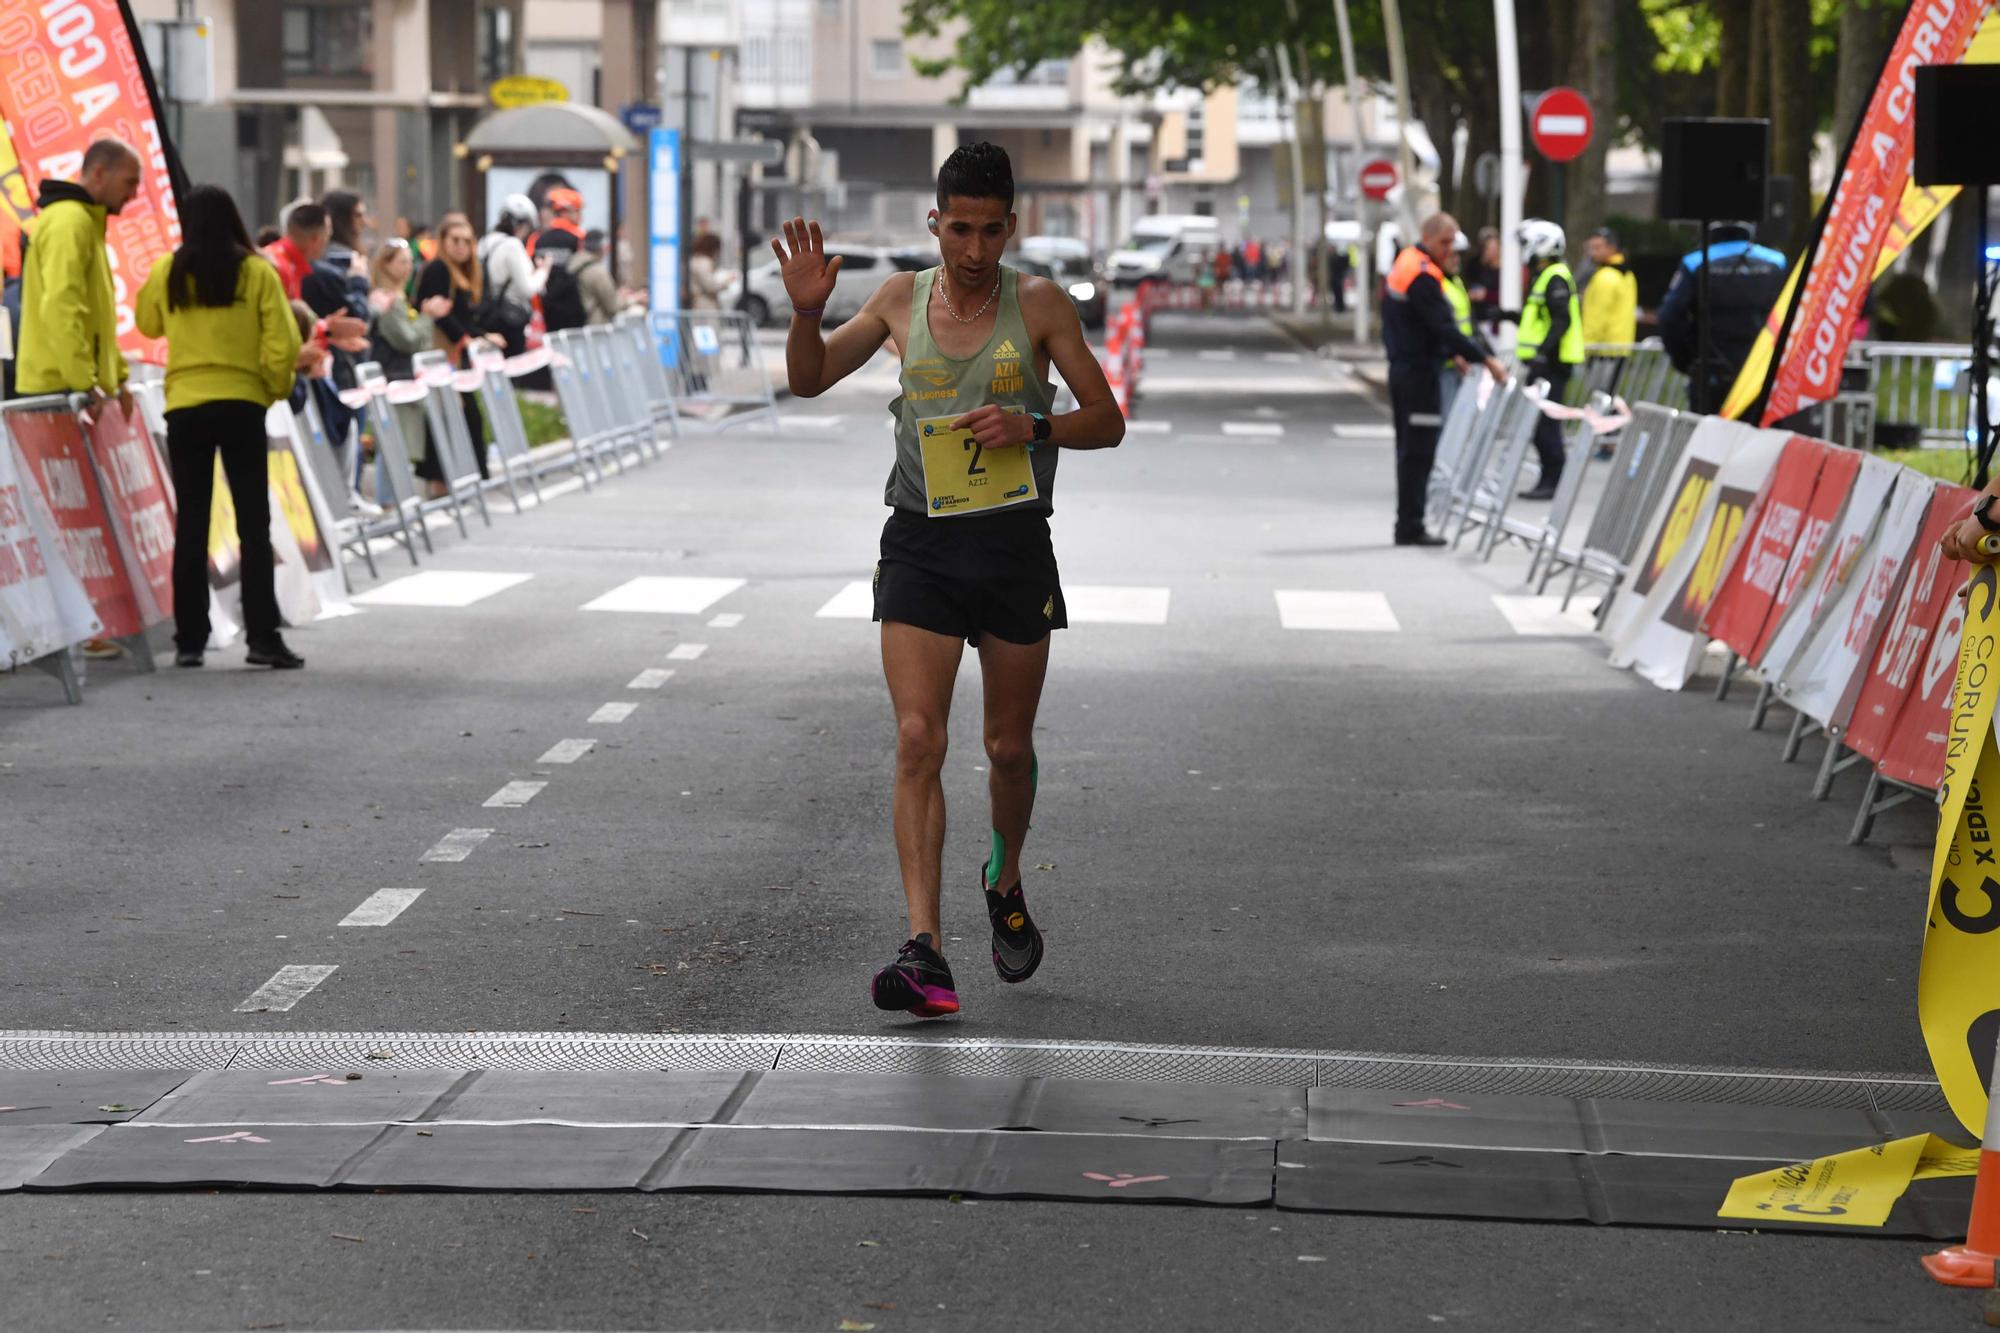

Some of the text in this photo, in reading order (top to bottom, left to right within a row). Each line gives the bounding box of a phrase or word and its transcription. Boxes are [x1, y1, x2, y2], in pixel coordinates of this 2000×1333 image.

[992, 351, 1021, 360] adidas
[995, 362, 1021, 377] AZIZ
[920, 388, 958, 401] Leonesa
[963, 437, 986, 475] 2
[967, 477, 988, 487] AZIZ
[1973, 847, 1996, 866] X
